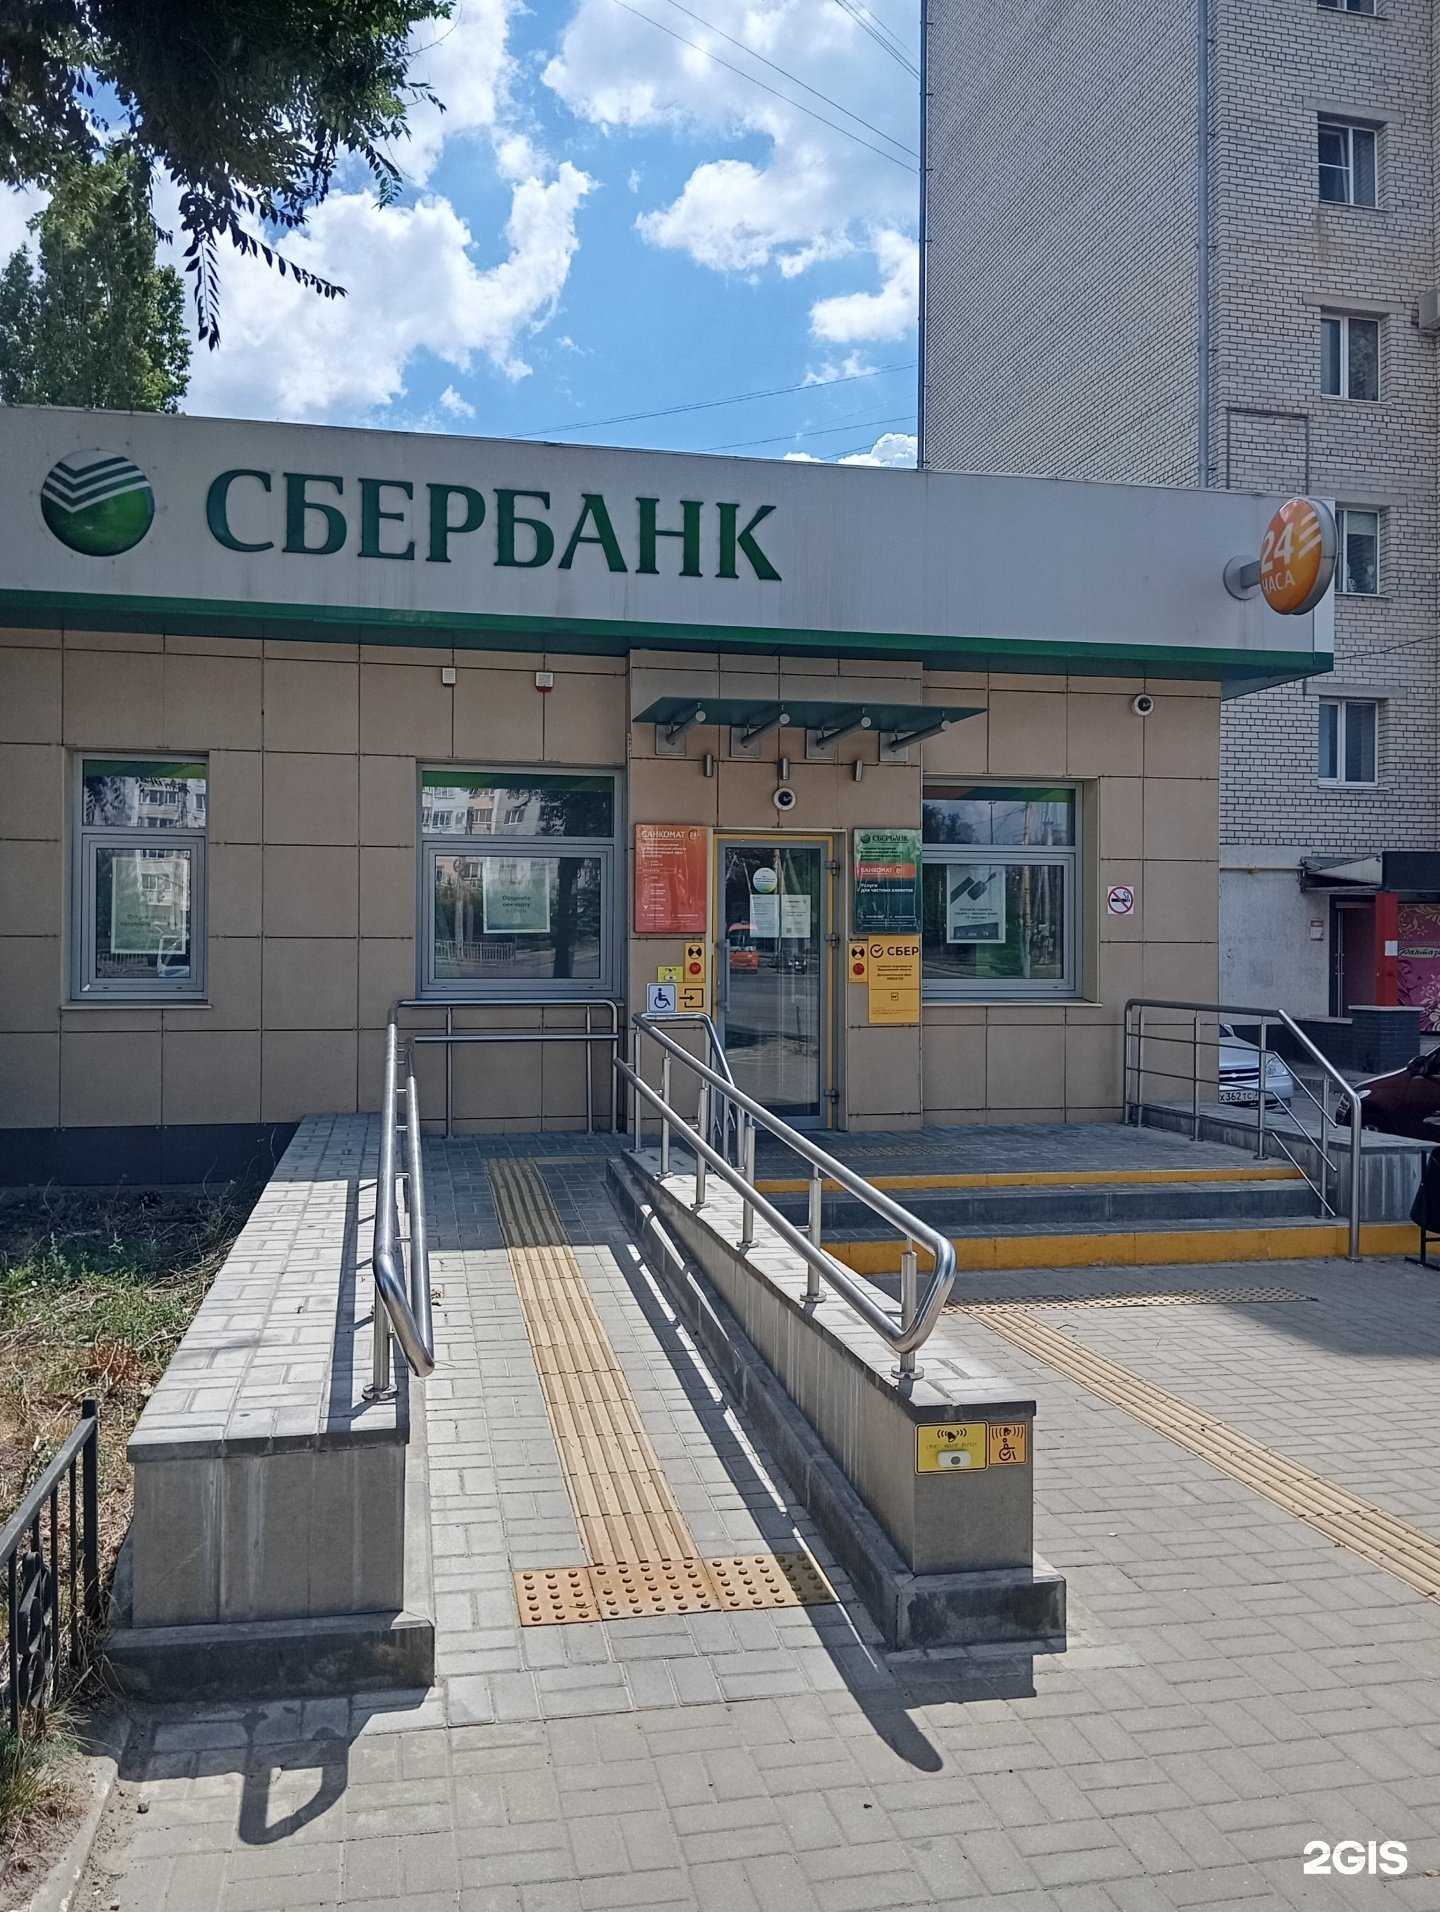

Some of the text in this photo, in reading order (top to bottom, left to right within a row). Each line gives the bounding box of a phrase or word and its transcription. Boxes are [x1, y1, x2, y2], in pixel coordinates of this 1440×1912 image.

[206, 469, 782, 581] СБЕРБАНК
[1262, 522, 1295, 573] 24
[1262, 570, 1296, 593] ЧАСА
[641, 830, 686, 839] БАНКОМАТ
[872, 834, 909, 842] СБЕРБАНК
[887, 946, 919, 956] СБЕР
